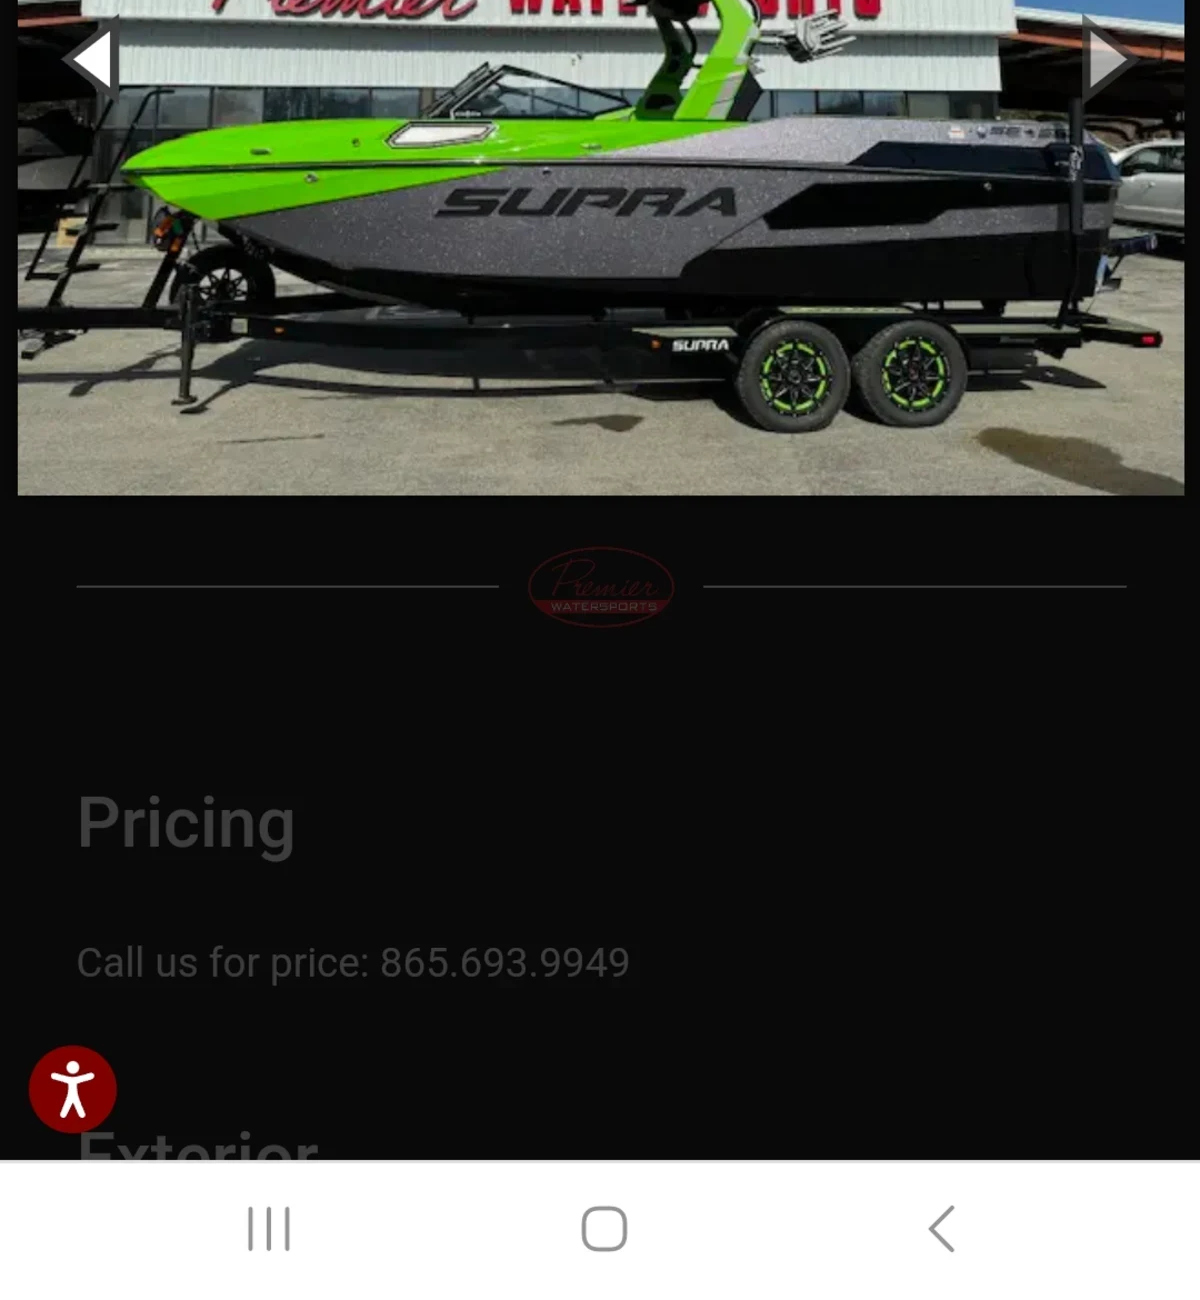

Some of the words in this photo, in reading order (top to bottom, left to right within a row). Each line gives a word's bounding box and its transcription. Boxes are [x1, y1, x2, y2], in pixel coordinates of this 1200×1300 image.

[434, 187, 738, 217] SUPRA
[672, 339, 729, 352] SUPRA
[551, 557, 660, 597] Premier
[550, 602, 658, 612] WATERSPORTS
[80, 794, 296, 863] Pricing
[77, 944, 143, 978] Call
[157, 953, 198, 978] us
[209, 944, 261, 978] for
[271, 947, 369, 987] price:
[381, 947, 629, 978] 865.693.9949
